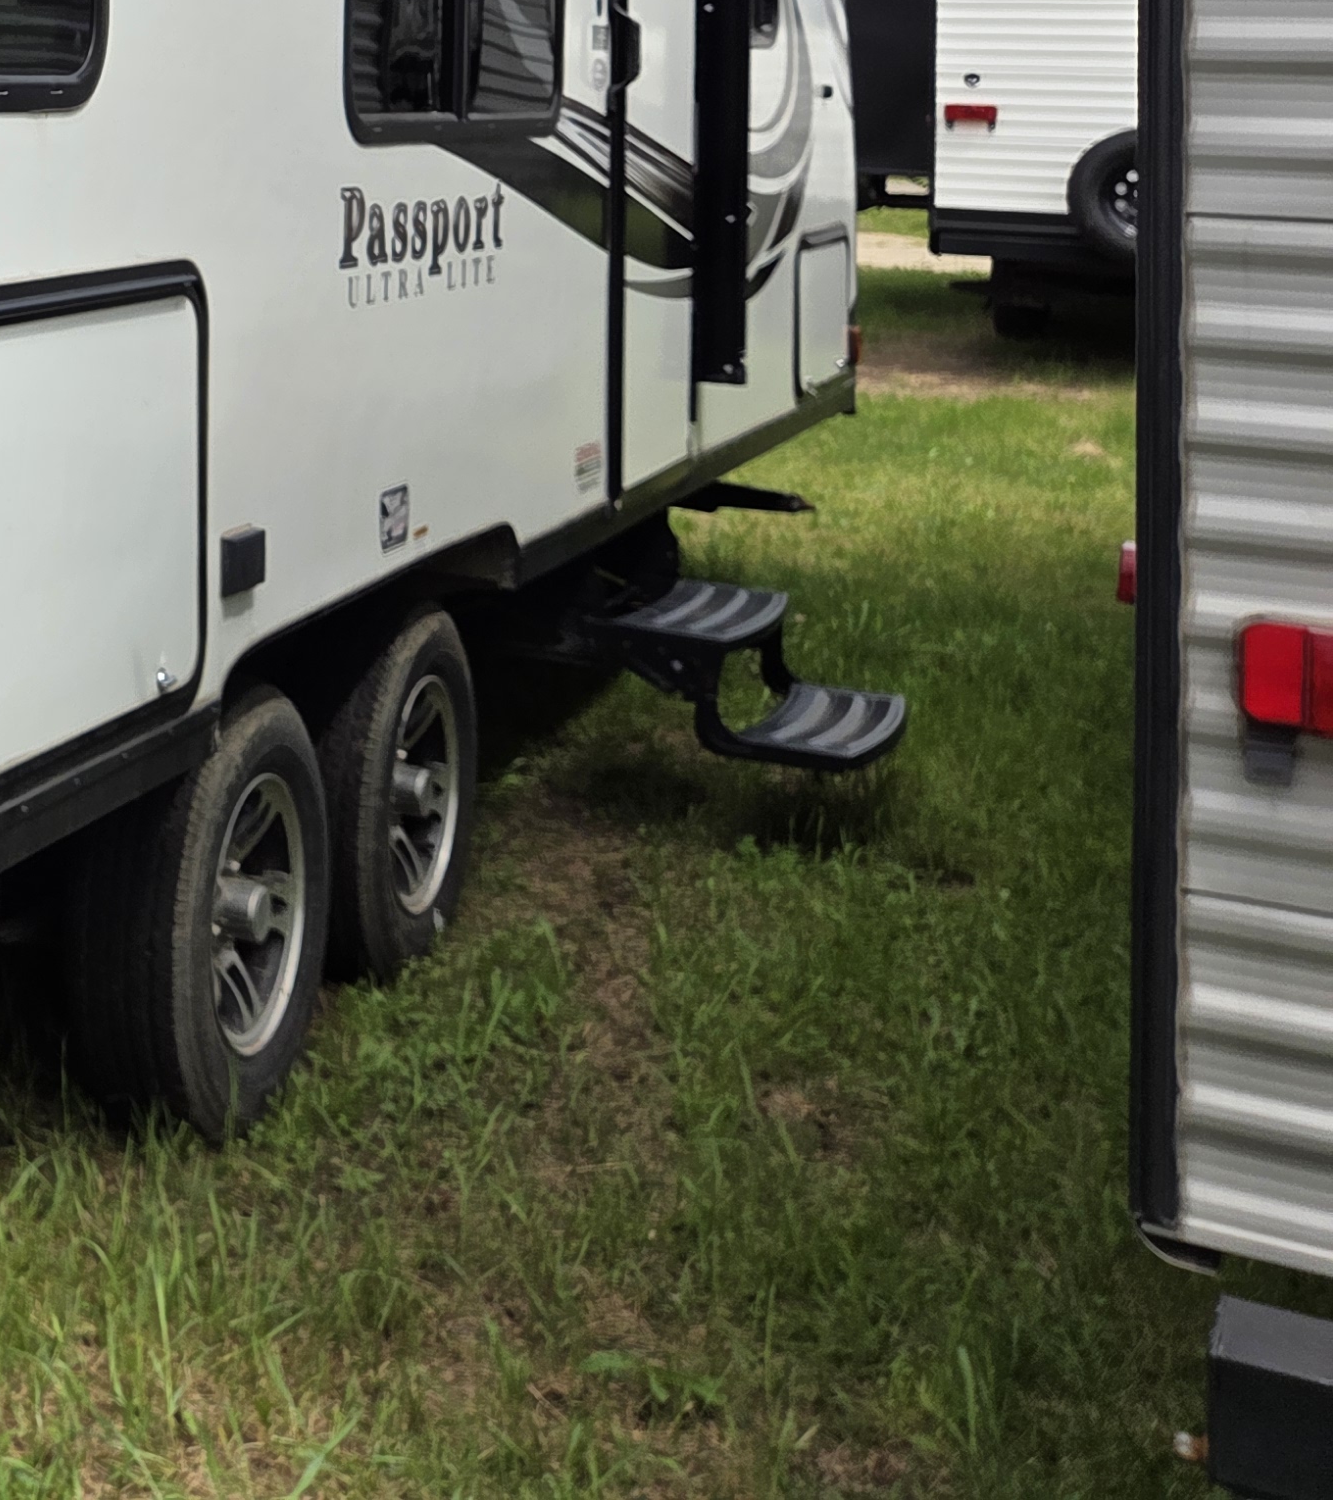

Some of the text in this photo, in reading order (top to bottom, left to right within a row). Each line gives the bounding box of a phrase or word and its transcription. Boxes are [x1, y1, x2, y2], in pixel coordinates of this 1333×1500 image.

[339, 179, 505, 276] Passport
[348, 254, 496, 309] ULTRA LITE
